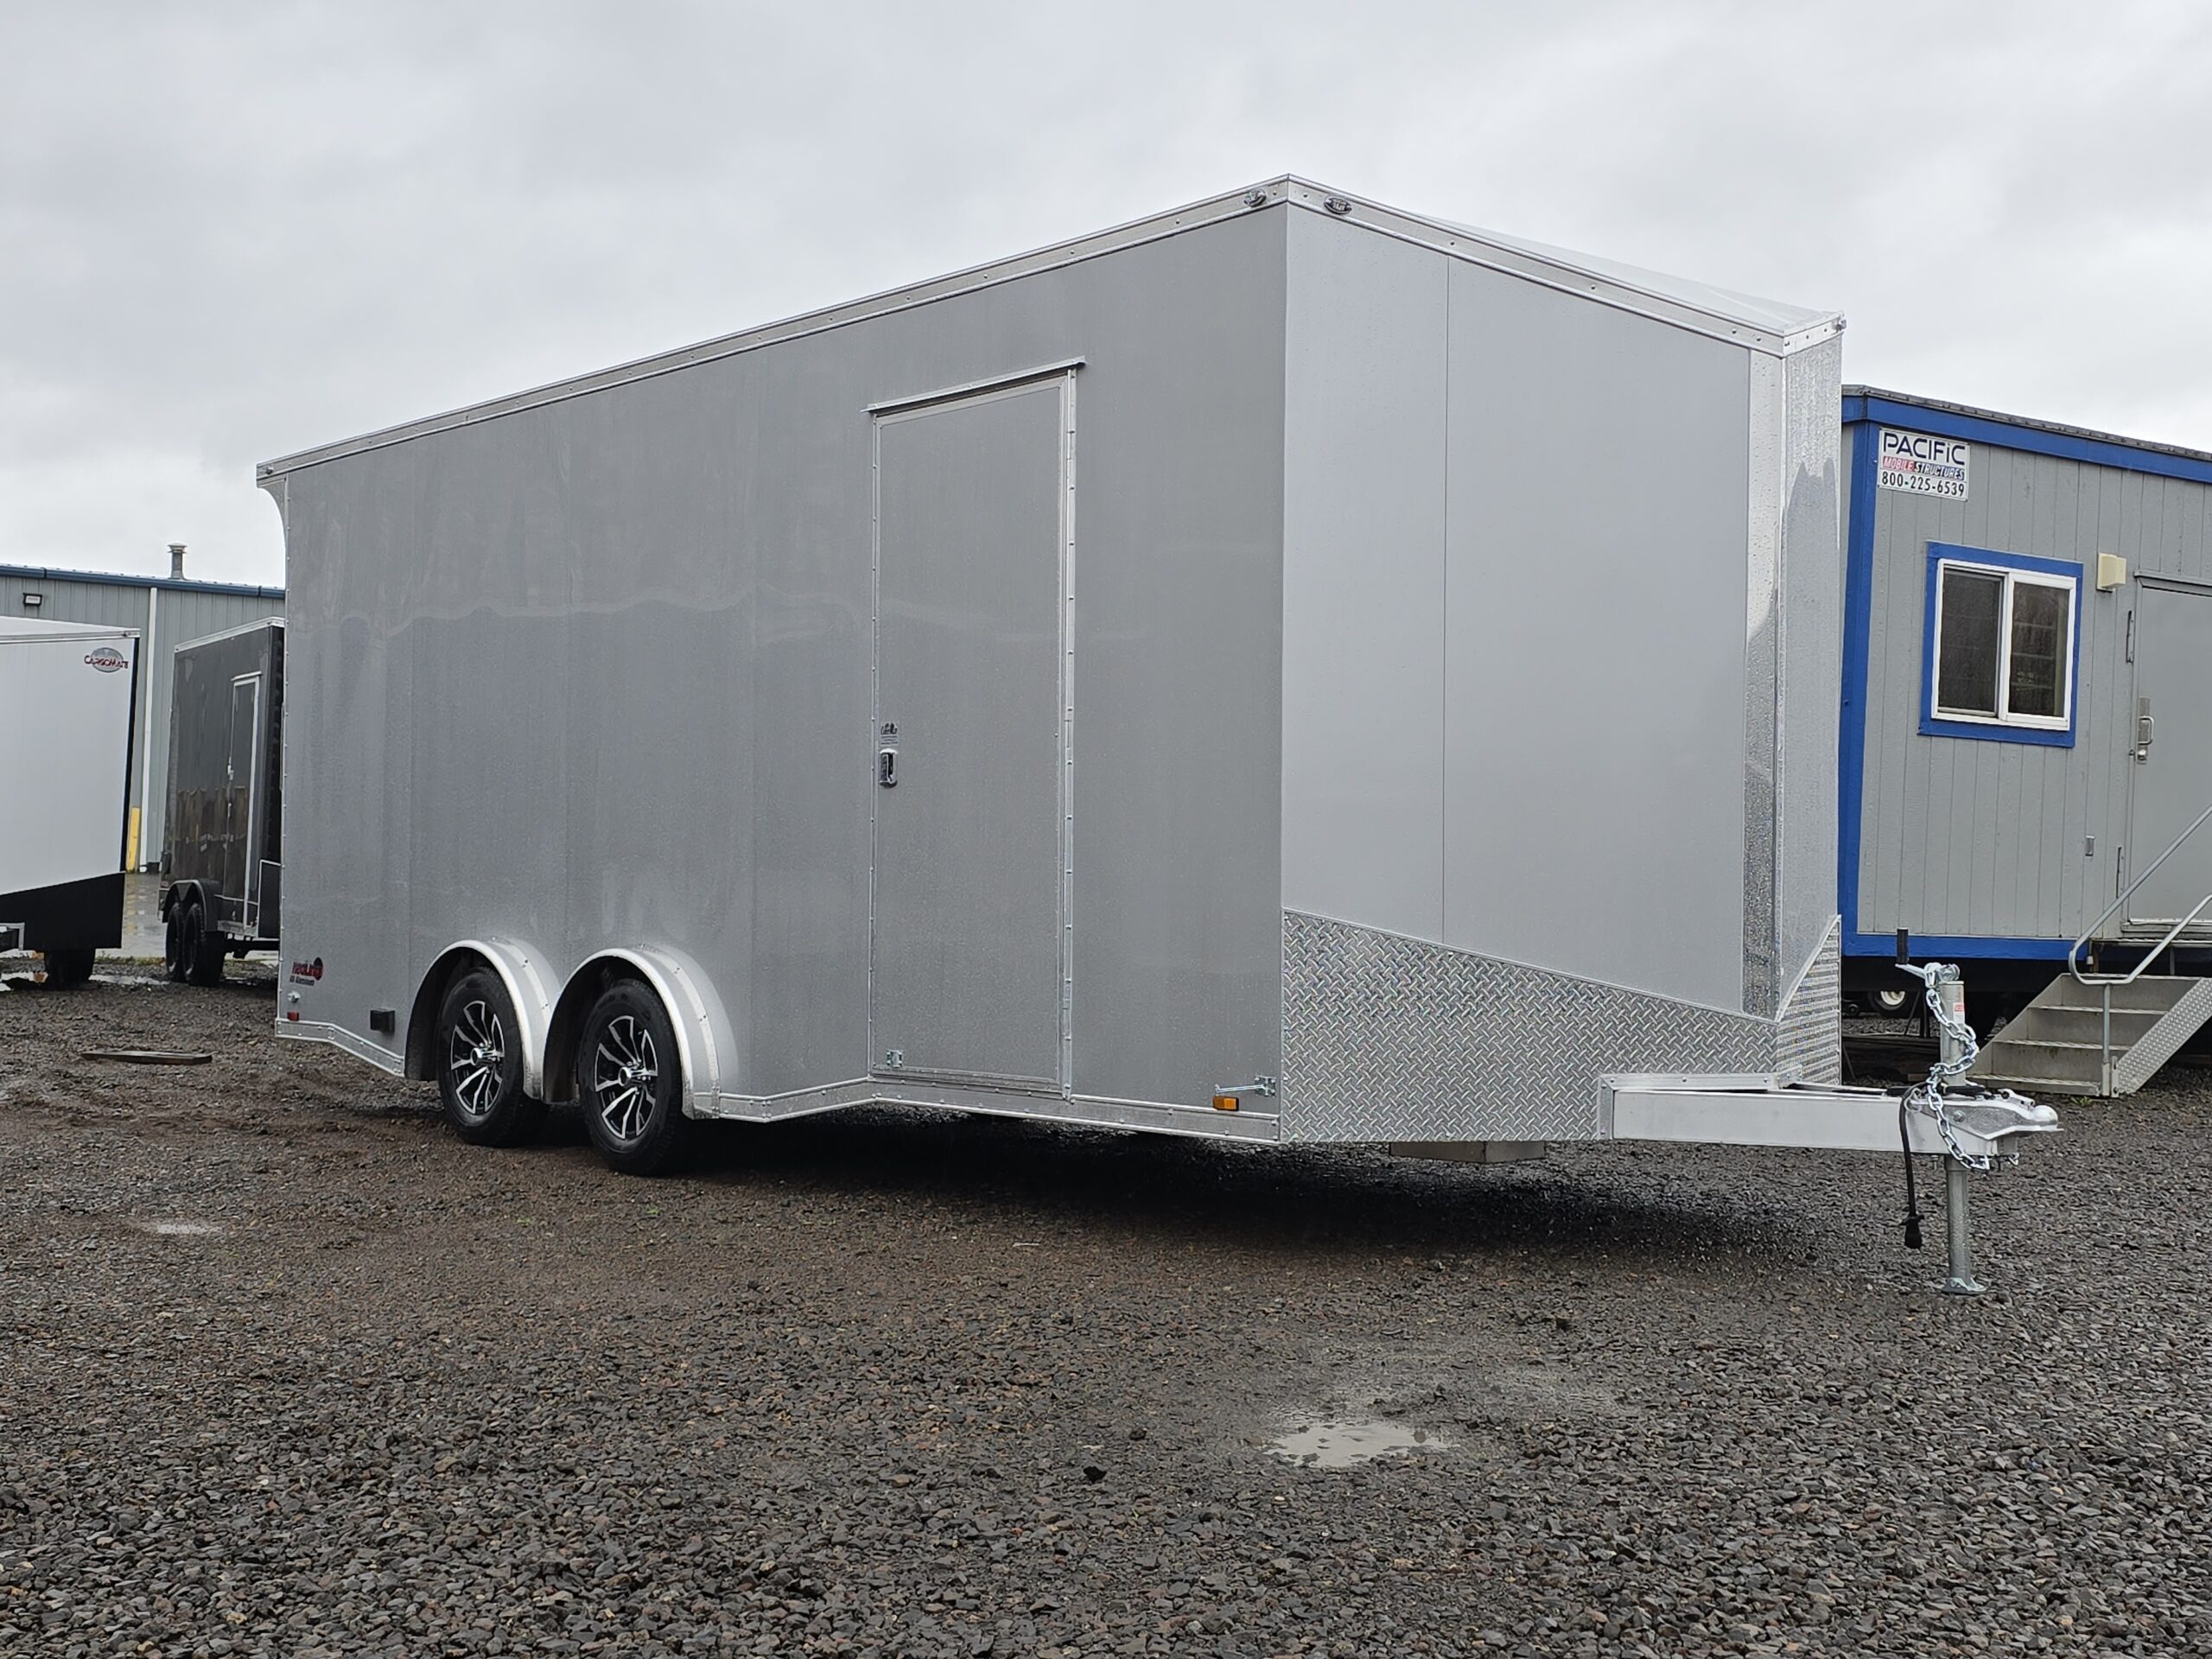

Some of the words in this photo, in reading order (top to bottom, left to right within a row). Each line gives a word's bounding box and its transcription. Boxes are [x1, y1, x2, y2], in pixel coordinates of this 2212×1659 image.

[1884, 456, 1915, 473] MOBILE
[1914, 461, 1966, 480] STRUCTURES
[1882, 471, 1965, 497] 800-225-6539
